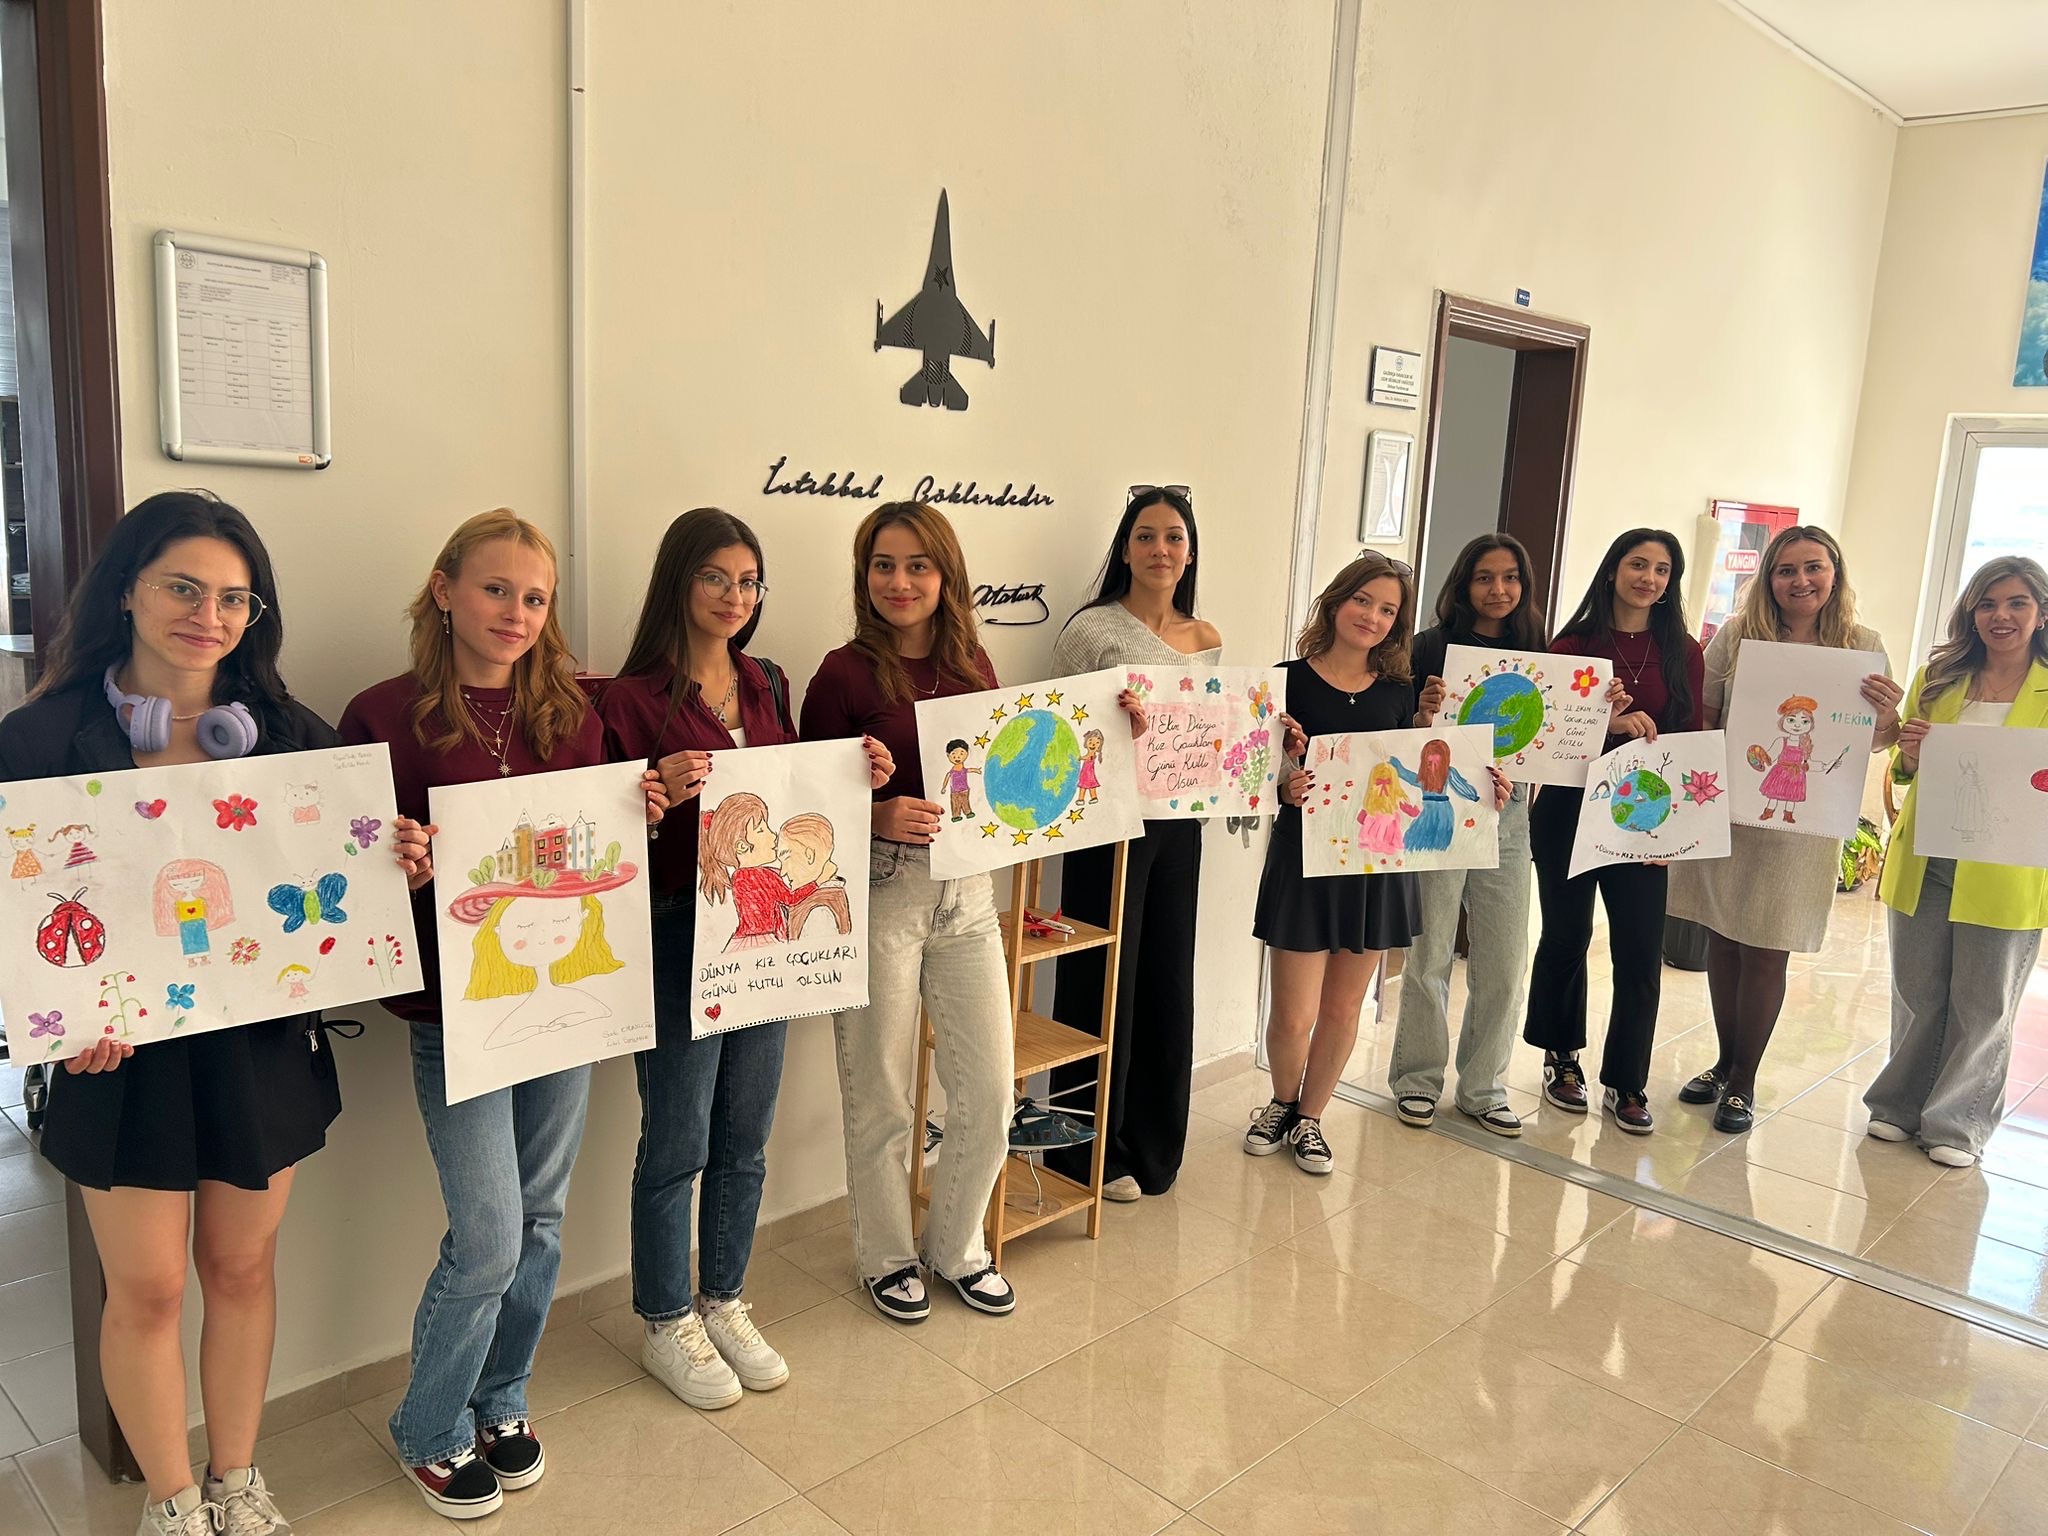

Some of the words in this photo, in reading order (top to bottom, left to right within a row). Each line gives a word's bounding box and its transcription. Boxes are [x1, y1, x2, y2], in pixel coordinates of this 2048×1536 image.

[1147, 714, 1156, 732] 11
[1187, 714, 1216, 738] Dünya
[1830, 712, 1843, 724] 11
[1844, 712, 1873, 726] EKİM
[1147, 737, 1166, 752] Kız
[1558, 738, 1584, 747] KUTLU
[1552, 751, 1580, 760] OLSUN
[1146, 754, 1176, 781] Günü
[1182, 752, 1209, 771] Kutlu
[1167, 772, 1198, 791] Olsun
[699, 962, 741, 983] DÜNYA
[755, 956, 776, 969] KIZ
[701, 982, 737, 1000] GÜNÜ
[747, 977, 784, 992] KUTLU
[797, 969, 842, 986] OLSUN
